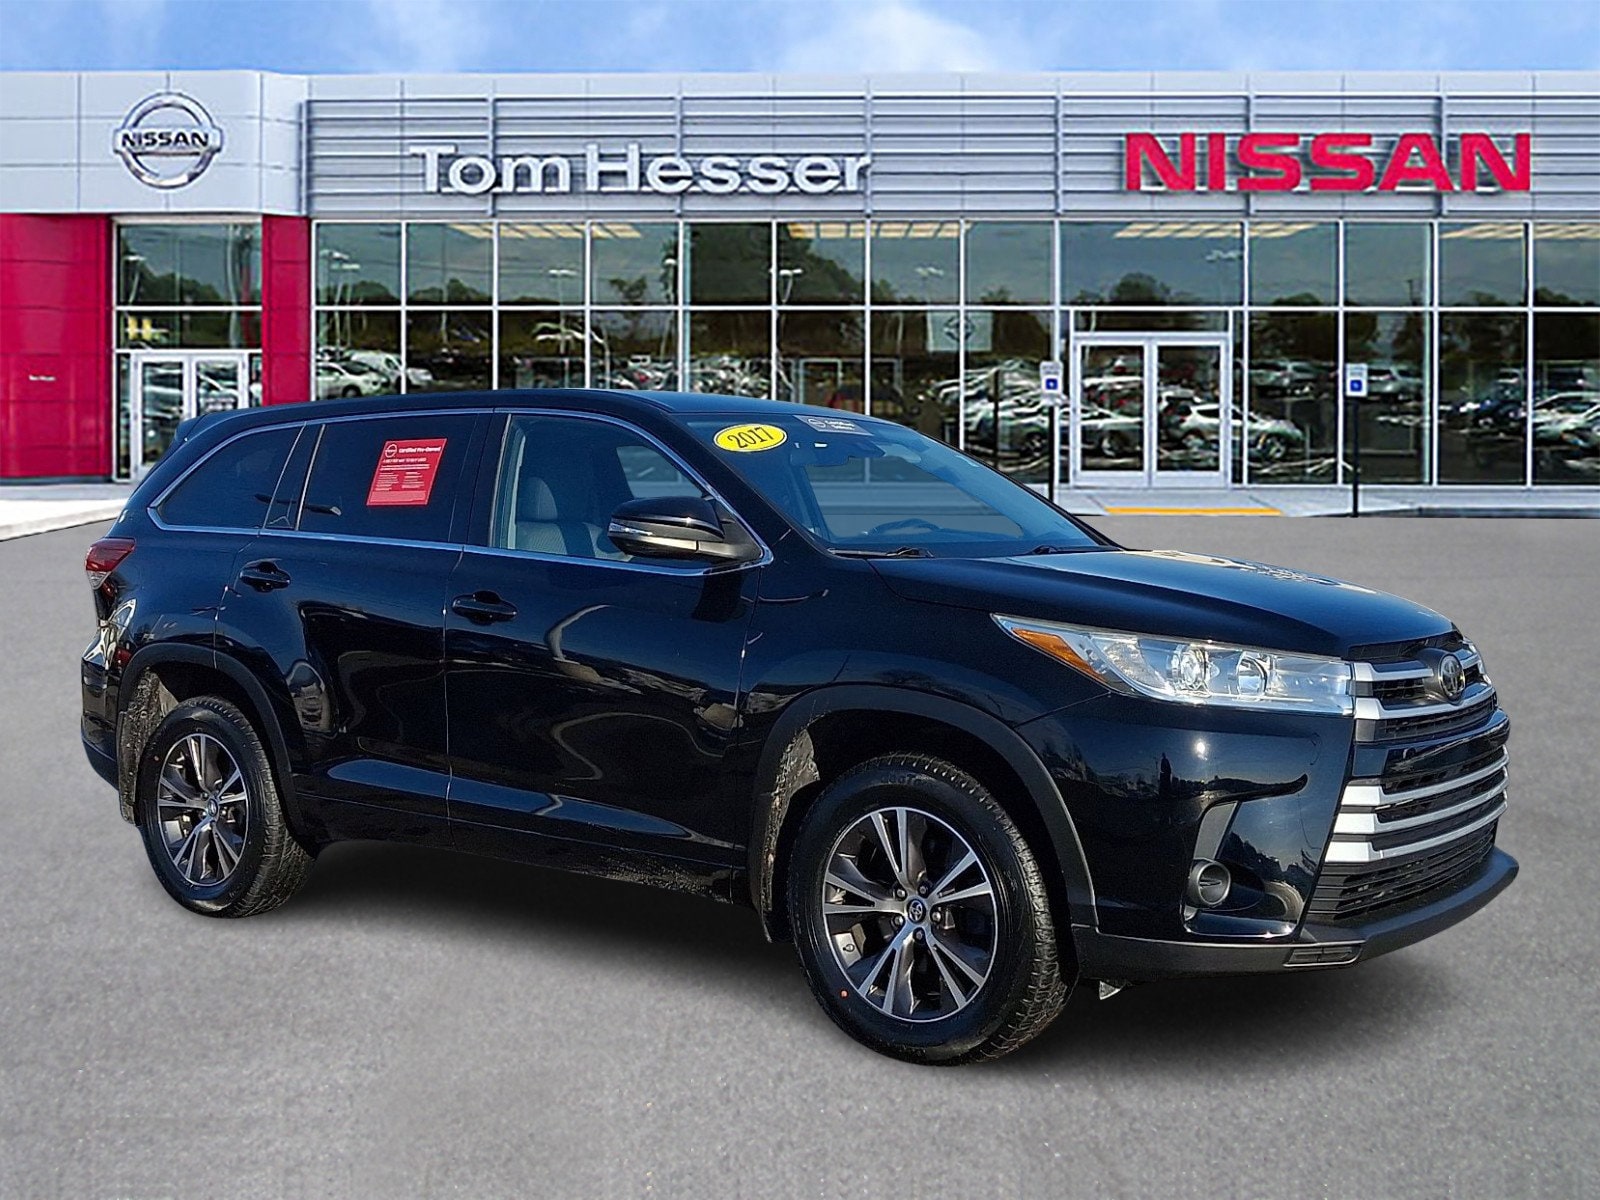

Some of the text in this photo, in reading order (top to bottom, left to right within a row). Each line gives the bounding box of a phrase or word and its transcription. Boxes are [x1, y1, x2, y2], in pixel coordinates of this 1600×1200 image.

[122, 131, 209, 148] NISSAN
[409, 142, 871, 194] Tom Hesser
[1125, 132, 1531, 191] NISSAN
[727, 426, 774, 449] 2017
